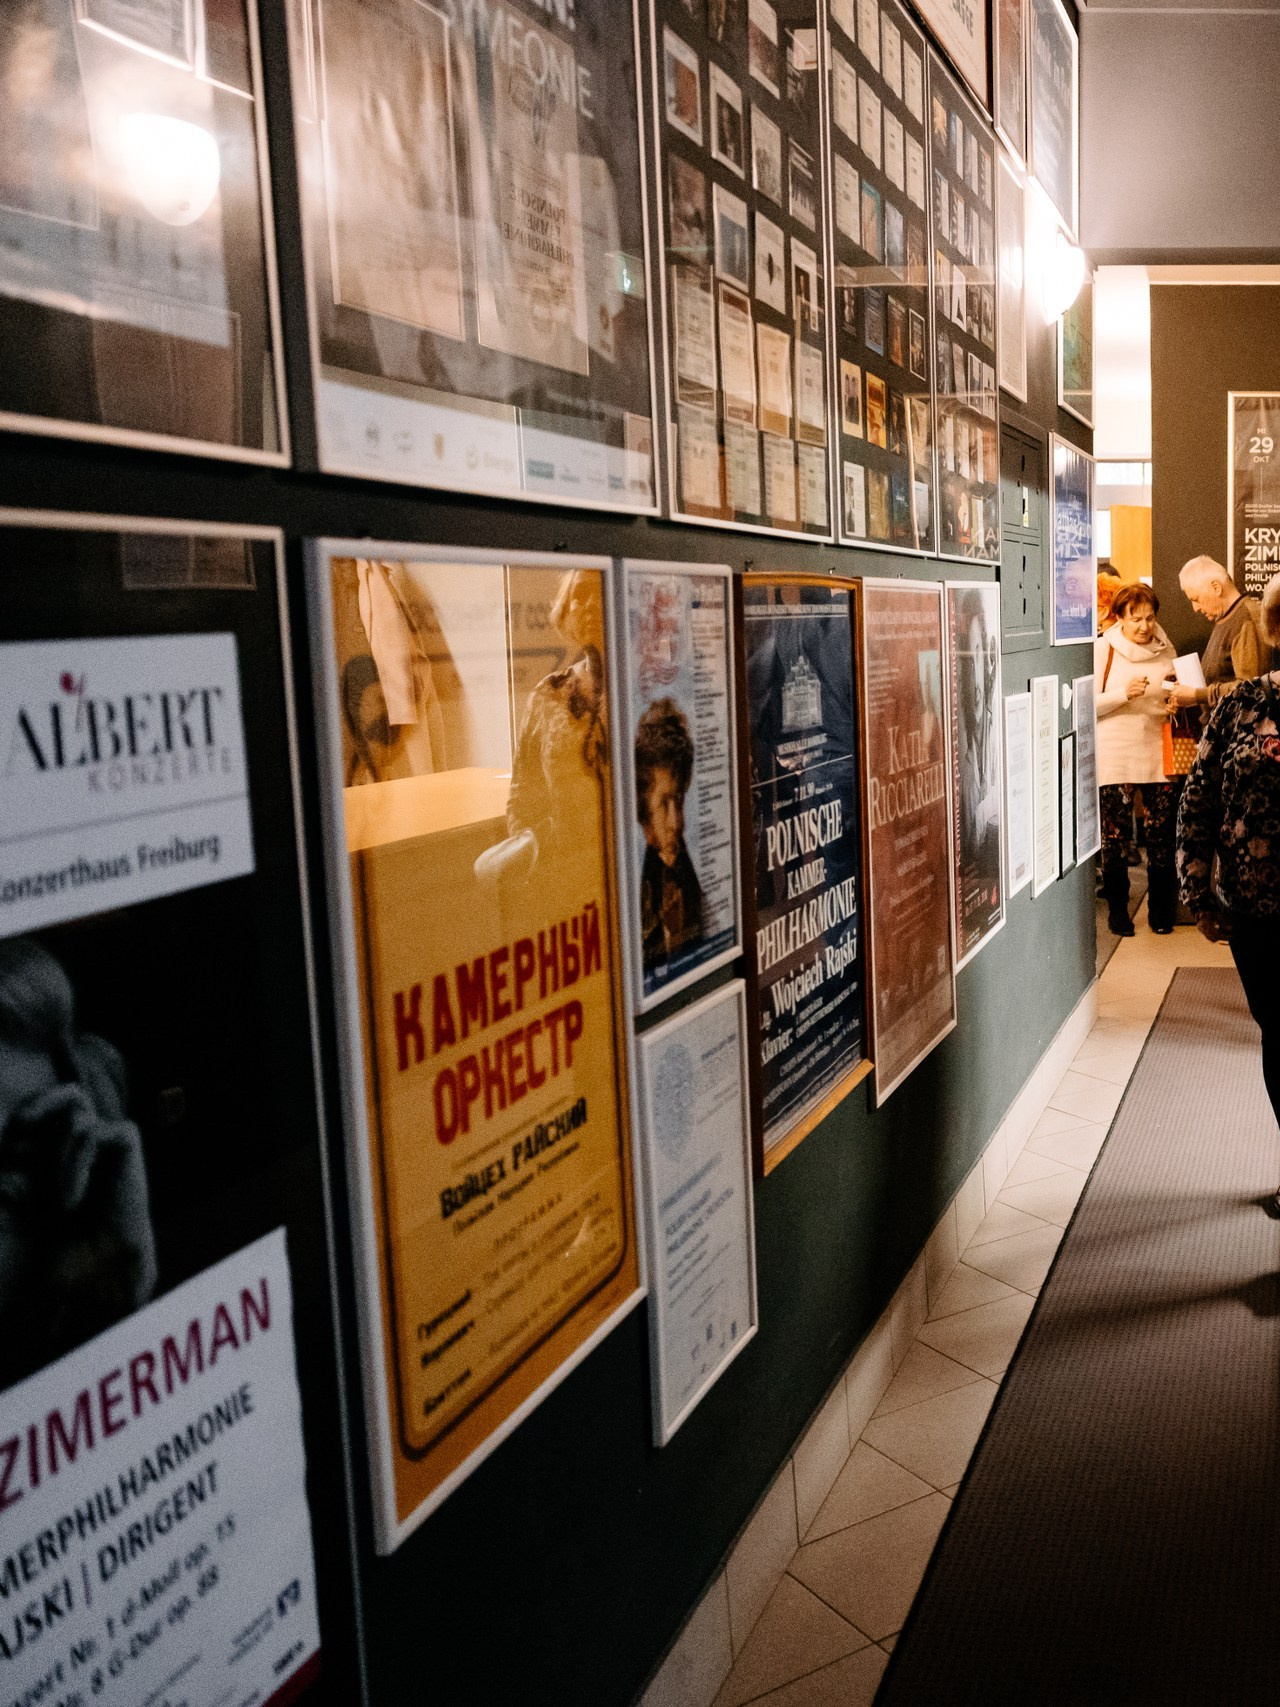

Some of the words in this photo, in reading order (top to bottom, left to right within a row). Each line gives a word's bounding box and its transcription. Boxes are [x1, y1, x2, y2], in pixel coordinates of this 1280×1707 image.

[1249, 436, 1274, 454] 29
[6, 686, 222, 773] ALBERT
[766, 798, 843, 872] POLNISCHE
[869, 763, 945, 832] RICCIARELLI
[0, 853, 131, 905] onzerthaus
[136, 834, 221, 864] Freiburg
[787, 856, 828, 900] KAMMER-
[756, 875, 857, 976] PHILHARMONIE
[393, 900, 602, 1072] КАМЕРНЫЙ
[770, 951, 824, 1018] Wojciech
[825, 928, 858, 979] Rajski
[433, 999, 584, 1147] ОРКЕСТР
[440, 1155, 507, 1220] ВОЙЦЕХ
[511, 1096, 588, 1171] РАЙСКИЙ
[0, 1276, 272, 1514] ZIMERMAN
[98, 1460, 220, 1583] DIRIGENT
